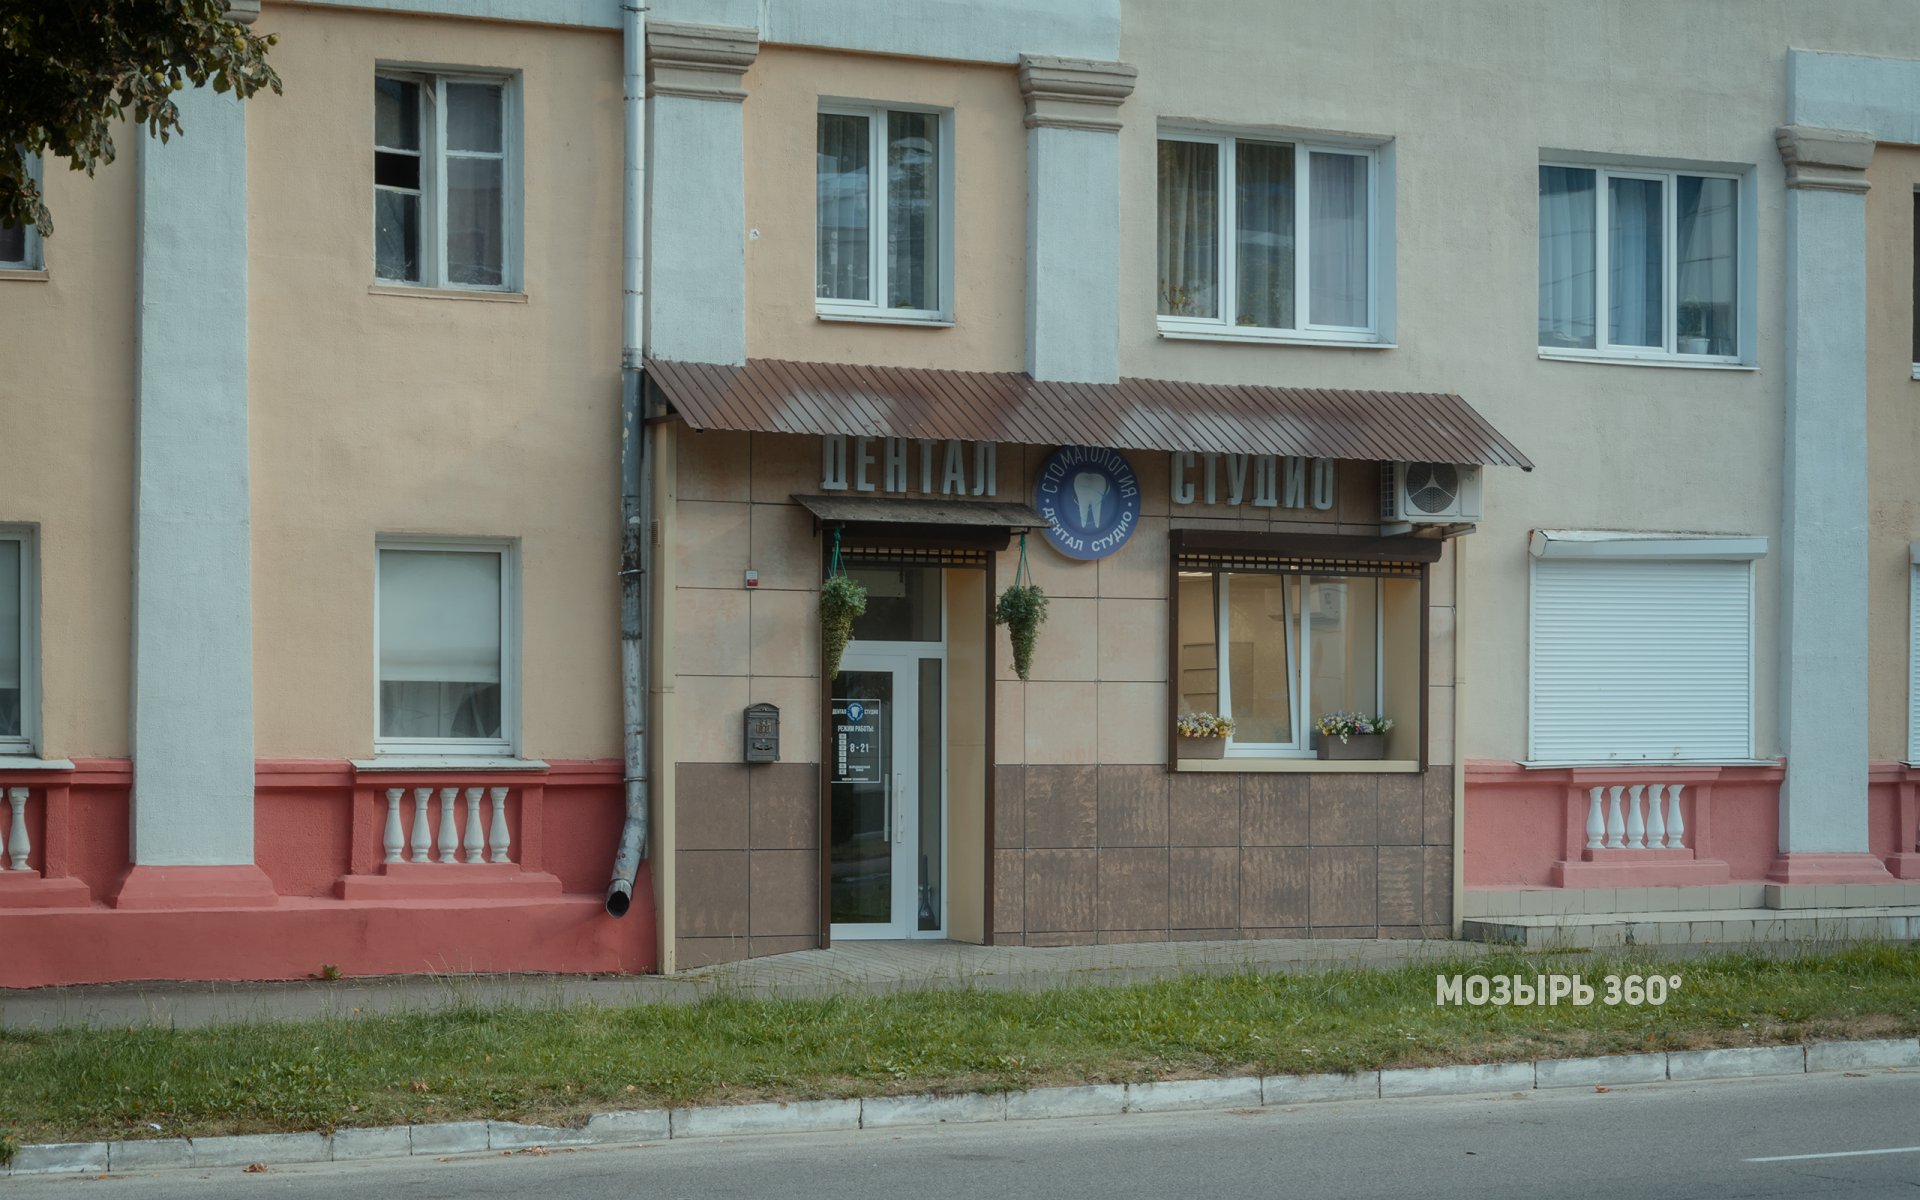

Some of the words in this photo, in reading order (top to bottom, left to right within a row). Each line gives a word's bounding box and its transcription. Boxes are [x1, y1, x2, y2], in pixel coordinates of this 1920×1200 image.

[819, 433, 997, 496] ДЕНТАЛ
[1171, 450, 1334, 511] СТУДИО
[1041, 446, 1137, 499] СТОМАТОЛОГИЯ
[1091, 511, 1132, 552] СТУДИО
